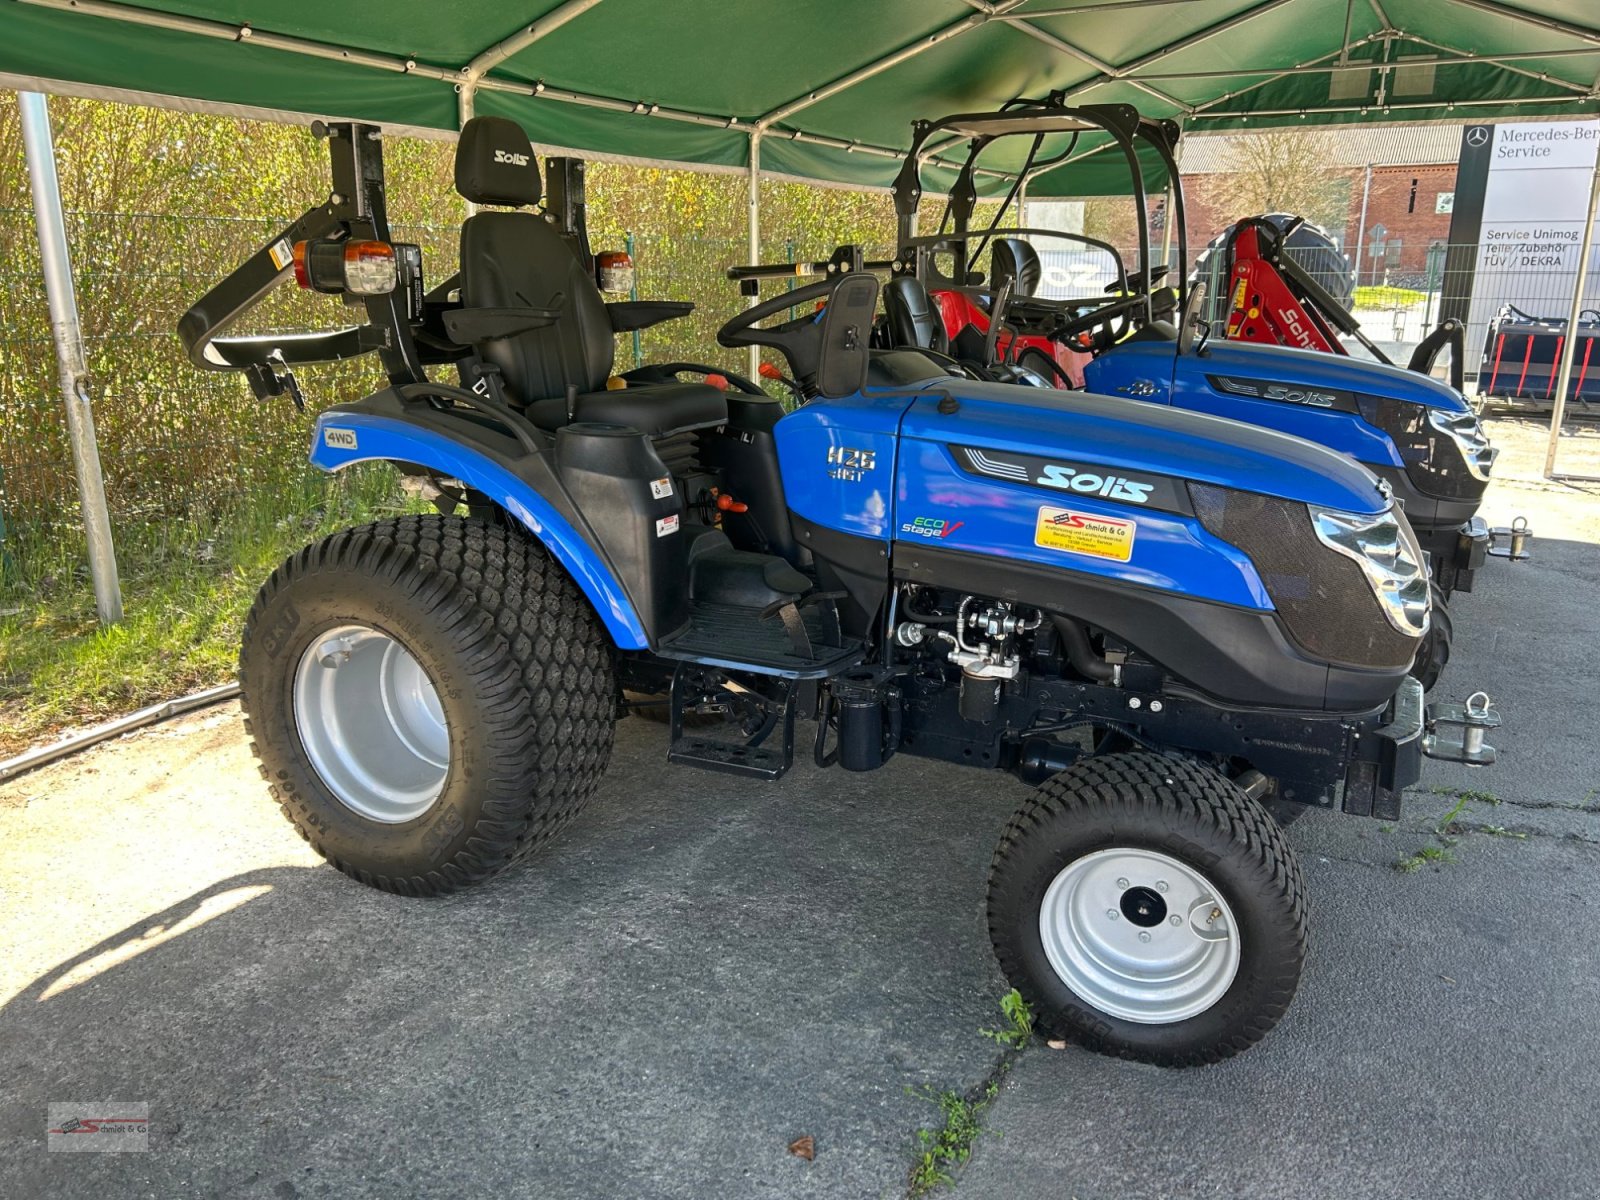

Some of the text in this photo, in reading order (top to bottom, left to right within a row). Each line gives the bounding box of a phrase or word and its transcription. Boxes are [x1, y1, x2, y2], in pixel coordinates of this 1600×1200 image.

[1498, 145, 1551, 158] Service
[1487, 229, 1579, 241] Service Unimog
[1484, 255, 1507, 266] TÜV
[1521, 256, 1562, 266] DEKRA
[328, 432, 353, 445] 4WD
[913, 516, 946, 528] ECO
[901, 523, 942, 538] stage
